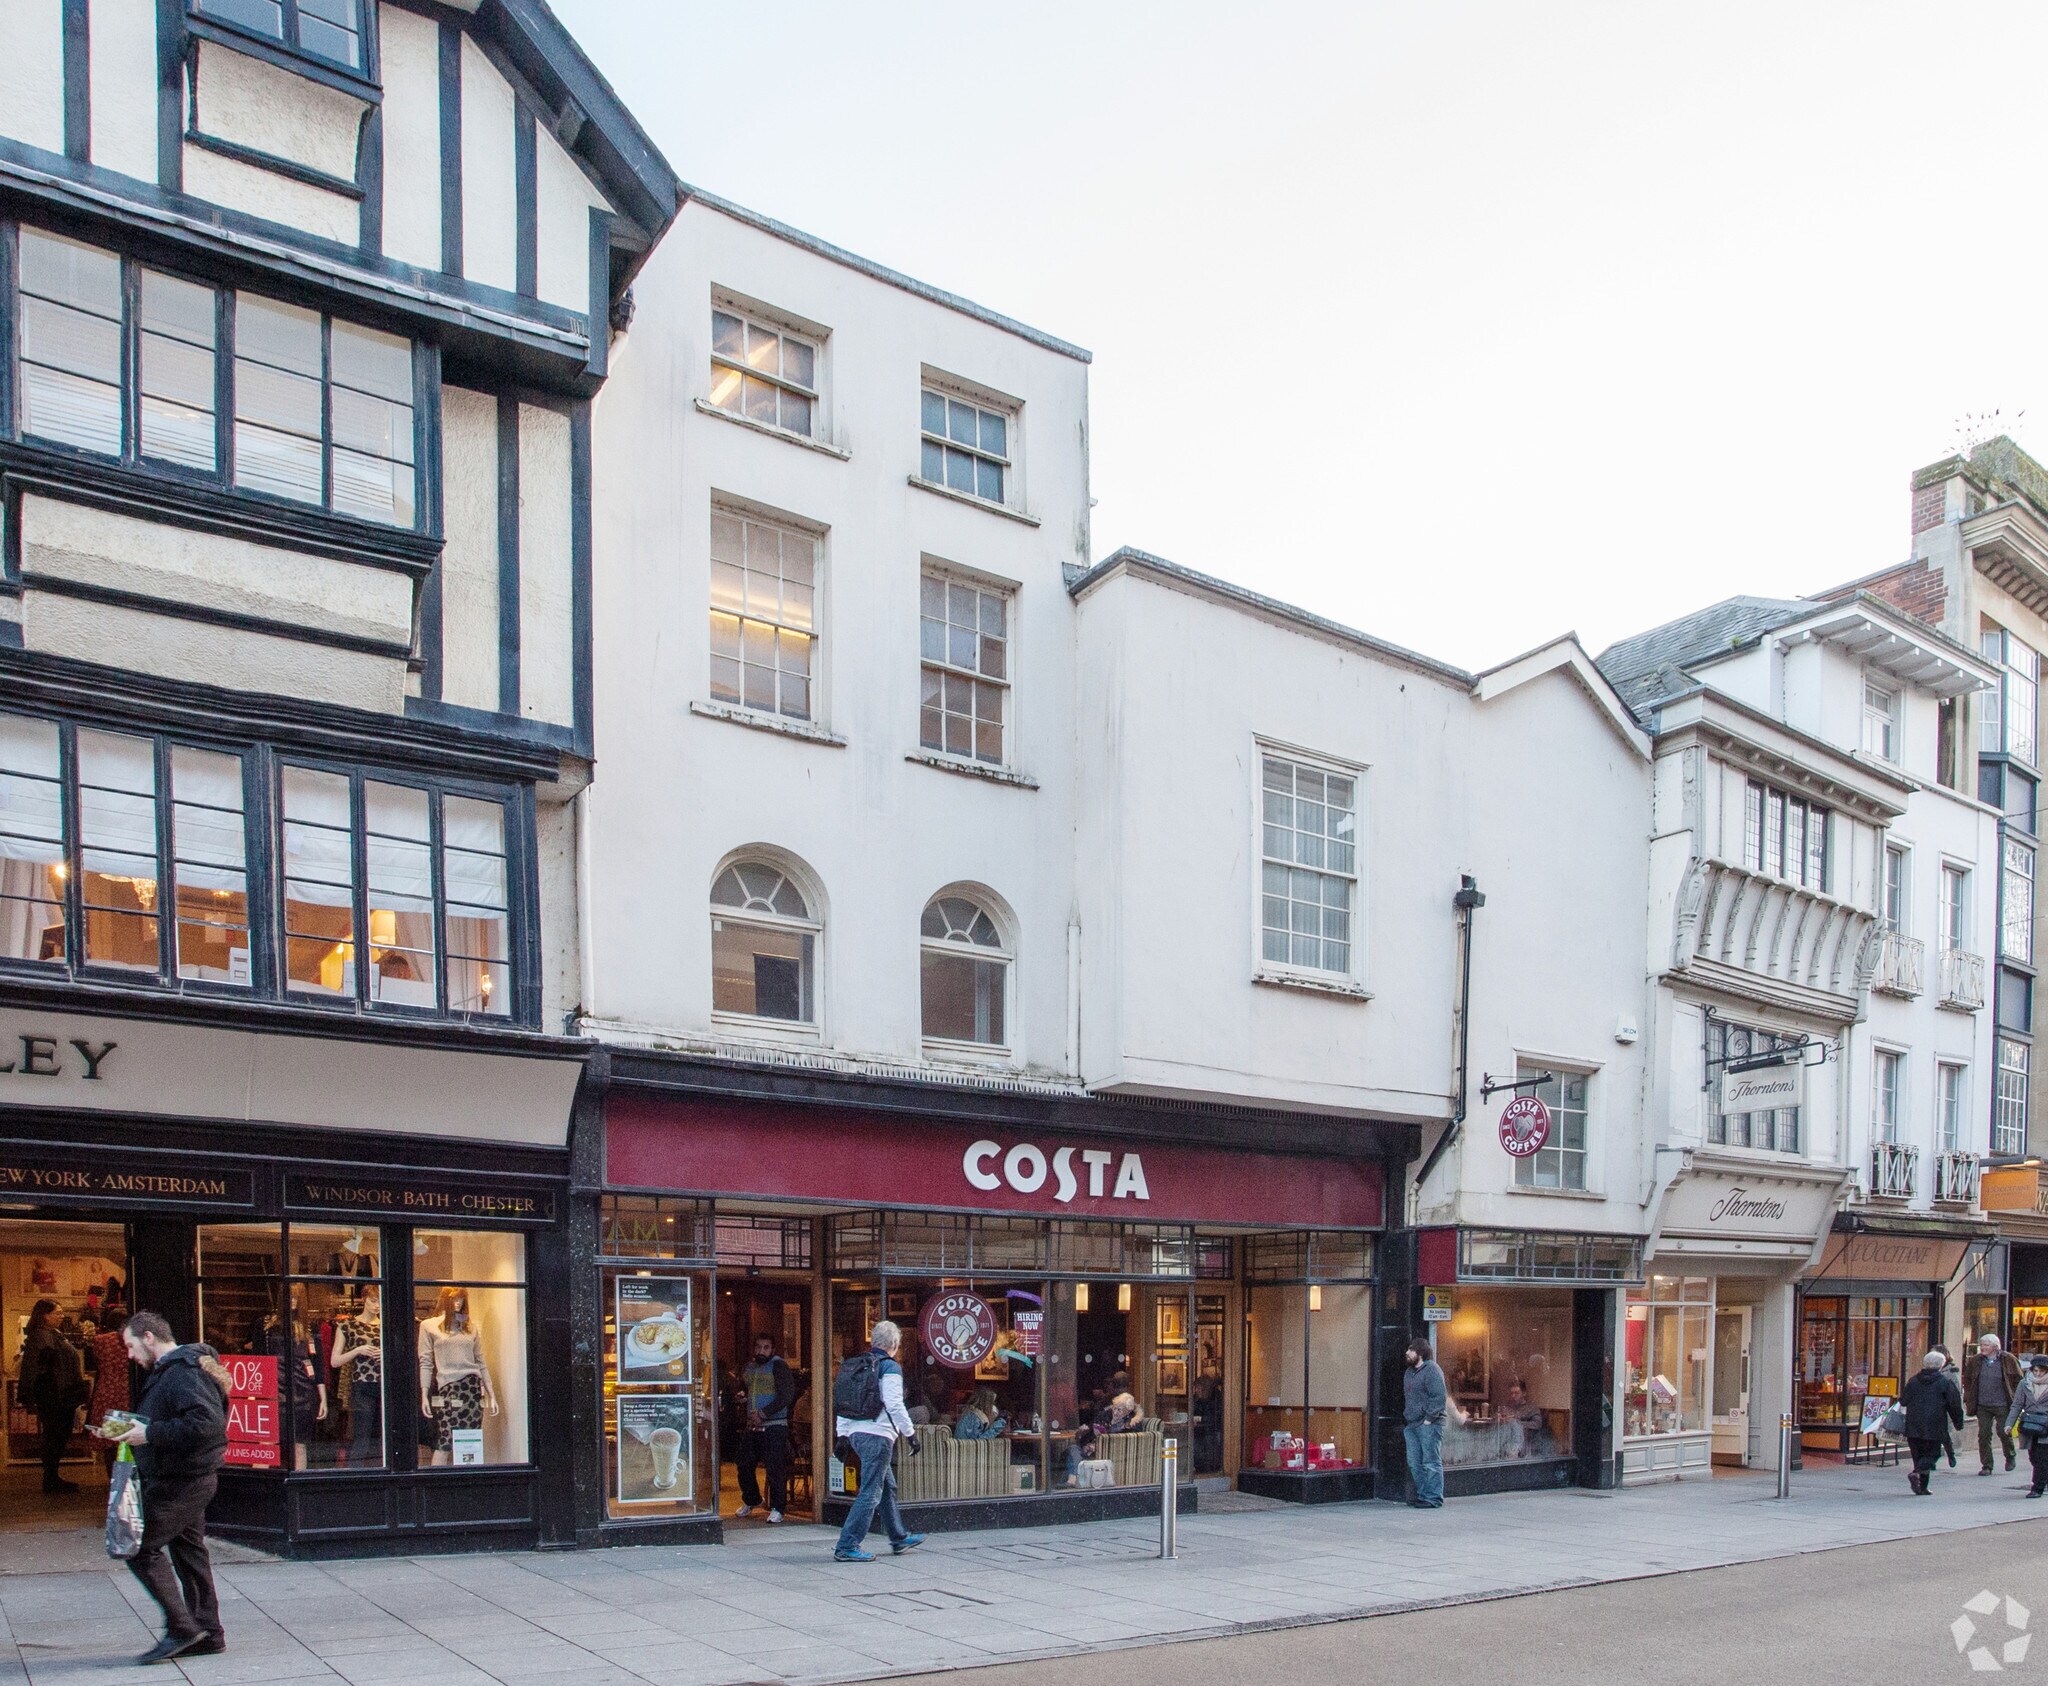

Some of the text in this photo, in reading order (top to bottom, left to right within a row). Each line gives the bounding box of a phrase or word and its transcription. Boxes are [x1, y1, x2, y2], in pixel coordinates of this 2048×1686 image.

[1728, 1079, 1795, 1102] Thorntons
[1507, 1100, 1540, 1120] COSTA
[1504, 1130, 1543, 1152] COFFEE
[31, 1169, 91, 1188] YORK
[102, 1173, 226, 1195] AMSTERDAM
[962, 1139, 1150, 1203] COSTA
[306, 1185, 536, 1212] WINDSOR BATH CHESTER
[1709, 1187, 1788, 1222] Thorntons
[1851, 1240, 1931, 1265] L'OCCITANE
[938, 1296, 983, 1317] COSTA
[1017, 1312, 1043, 1322] HIRING
[1022, 1321, 1039, 1330] NOW
[934, 1335, 989, 1360] COFFEE
[247, 1381, 263, 1391] OFF
[226, 1403, 271, 1434] ALE
[1867, 1401, 1886, 1417] Sale
[232, 1448, 250, 1458] LINES
[250, 1449, 276, 1460] ADDED
